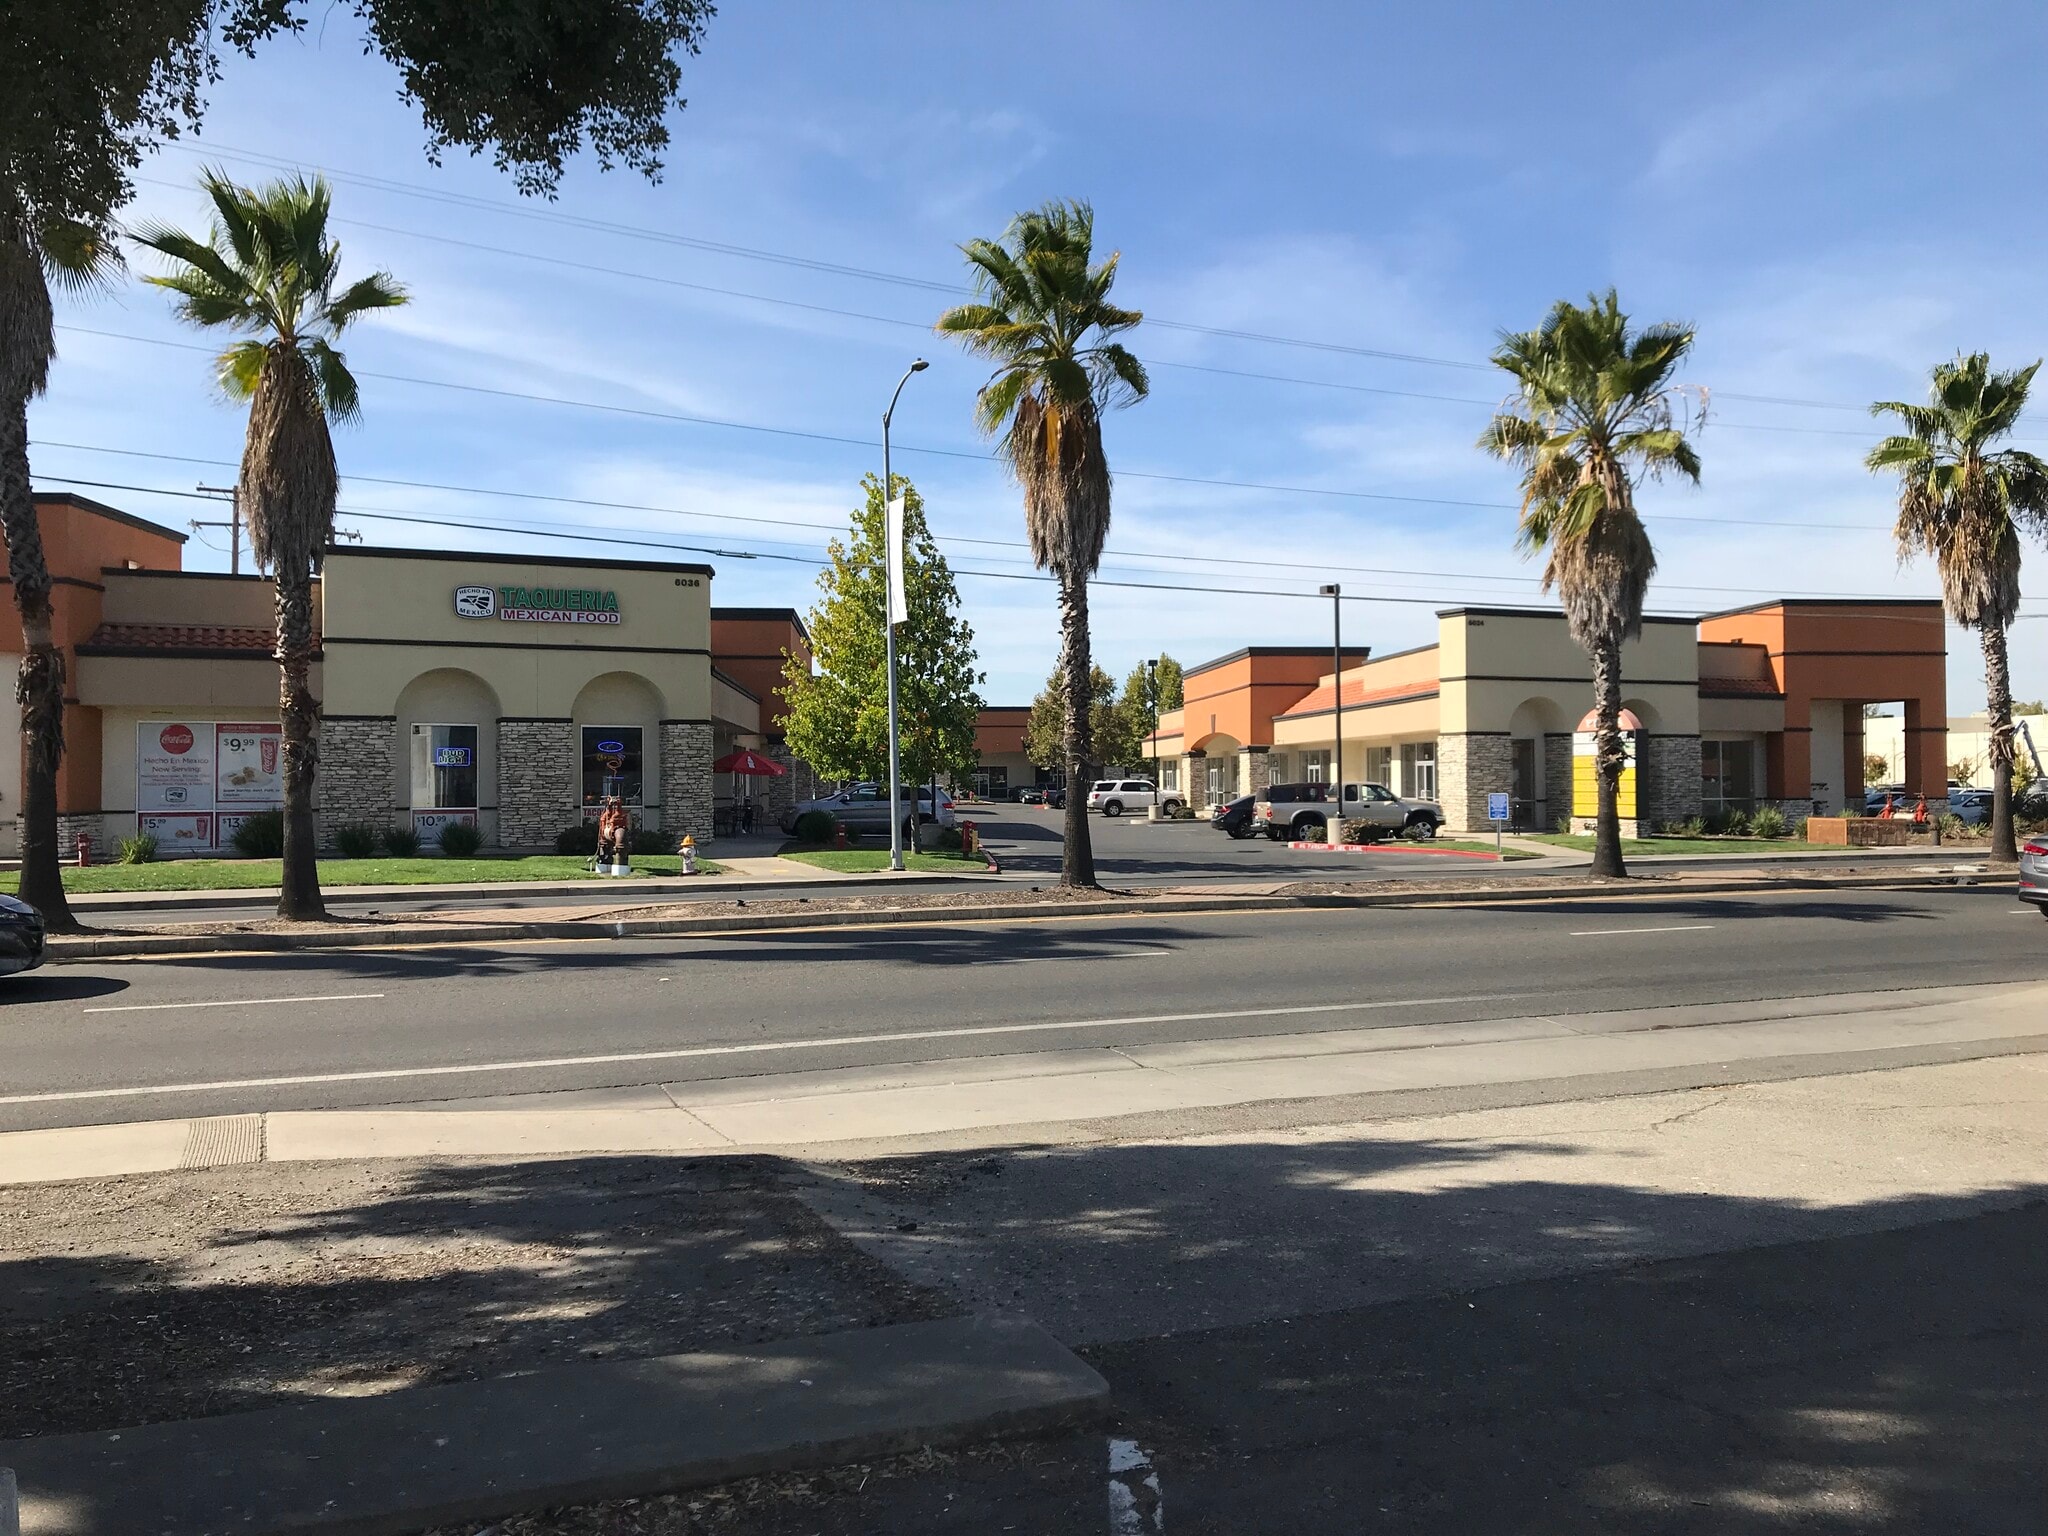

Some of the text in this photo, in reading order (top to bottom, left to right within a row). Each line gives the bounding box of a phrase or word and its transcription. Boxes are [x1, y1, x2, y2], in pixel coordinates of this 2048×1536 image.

[674, 578, 700, 587] 6036
[499, 586, 619, 611] TAQUERIA
[459, 607, 492, 616] MEXICO
[503, 609, 619, 624] MEXICAN FOOD
[442, 749, 465, 757] BUD
[144, 757, 169, 765] Hecho
[182, 757, 209, 765] Mexico
